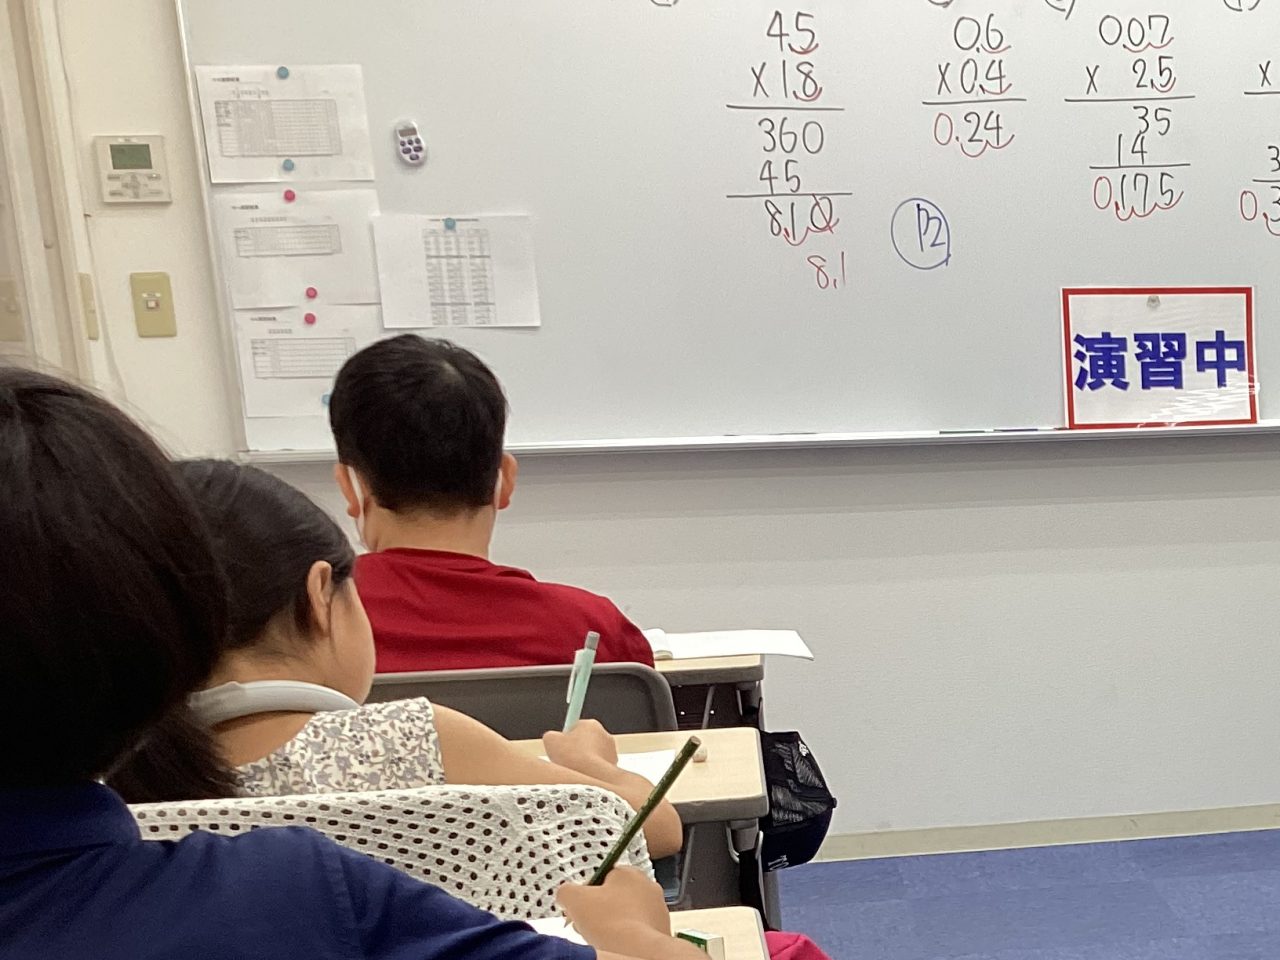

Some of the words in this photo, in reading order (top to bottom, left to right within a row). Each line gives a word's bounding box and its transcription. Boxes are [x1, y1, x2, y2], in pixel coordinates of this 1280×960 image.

[952, 13, 1005, 54] 0.6
[757, 116, 825, 155] 360
[933, 110, 1004, 147] 0.24
[1132, 105, 1172, 137] 35
[1117, 131, 1148, 168] 14
[759, 159, 802, 196] 45
[806, 251, 847, 290] 8.1
[1073, 330, 1246, 391] 演習中
